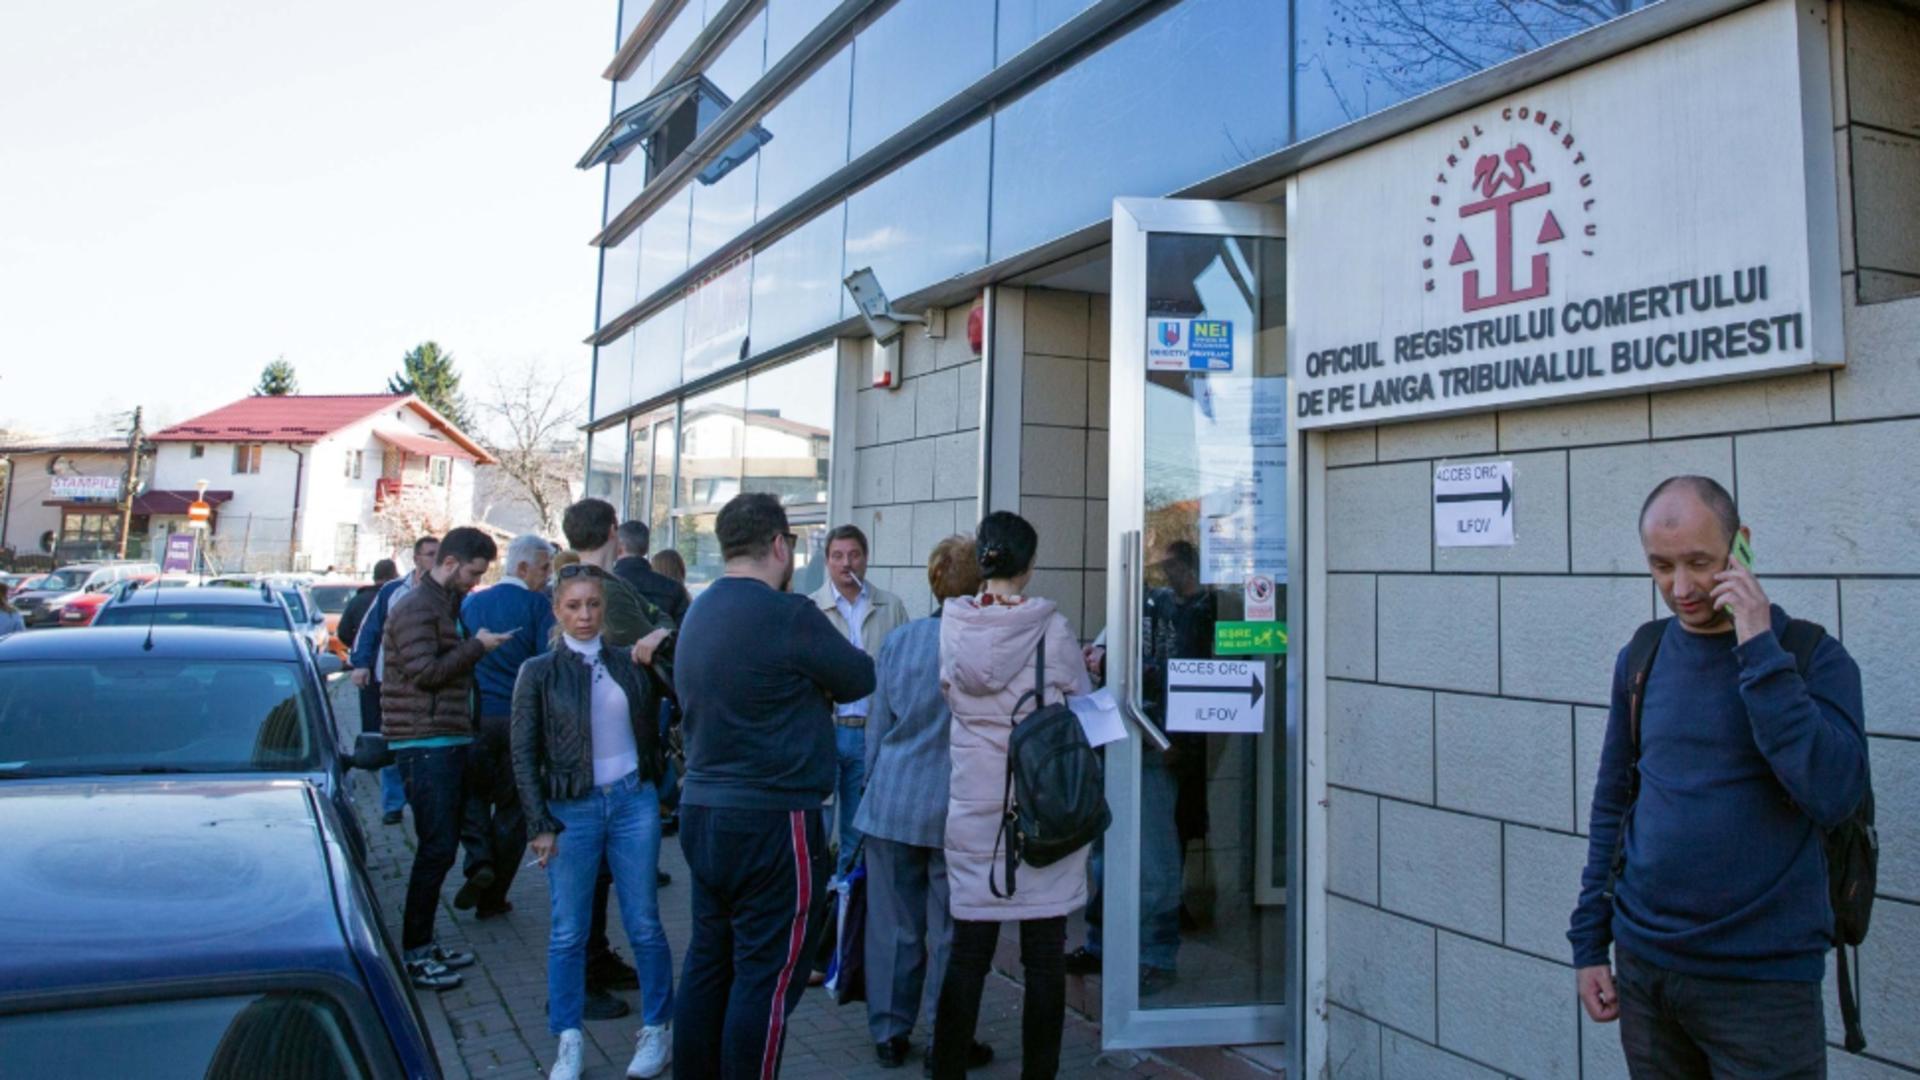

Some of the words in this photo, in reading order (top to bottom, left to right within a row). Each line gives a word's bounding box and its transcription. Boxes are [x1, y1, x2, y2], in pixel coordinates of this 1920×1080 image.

[1502, 107, 1597, 257] COMERTULUI
[1306, 341, 1385, 378] OFICIUL
[1394, 306, 1555, 365] REGISTRULUI
[1562, 265, 1768, 334] COMERTULUI
[1297, 387, 1324, 417] DE
[1327, 381, 1354, 411] PE
[1359, 370, 1434, 407] LANGA
[1440, 345, 1605, 397] TRIBUNALUL
[1612, 312, 1804, 374] BUCURESTI
[1436, 467, 1472, 482] ACCES
[1474, 464, 1499, 480] ORC
[53, 477, 119, 489] STAMPILE
[1456, 518, 1491, 533] ILFOV
[1169, 662, 1216, 676] ACCES
[1218, 662, 1248, 676] ORC
[1195, 707, 1238, 721] ILFOV
